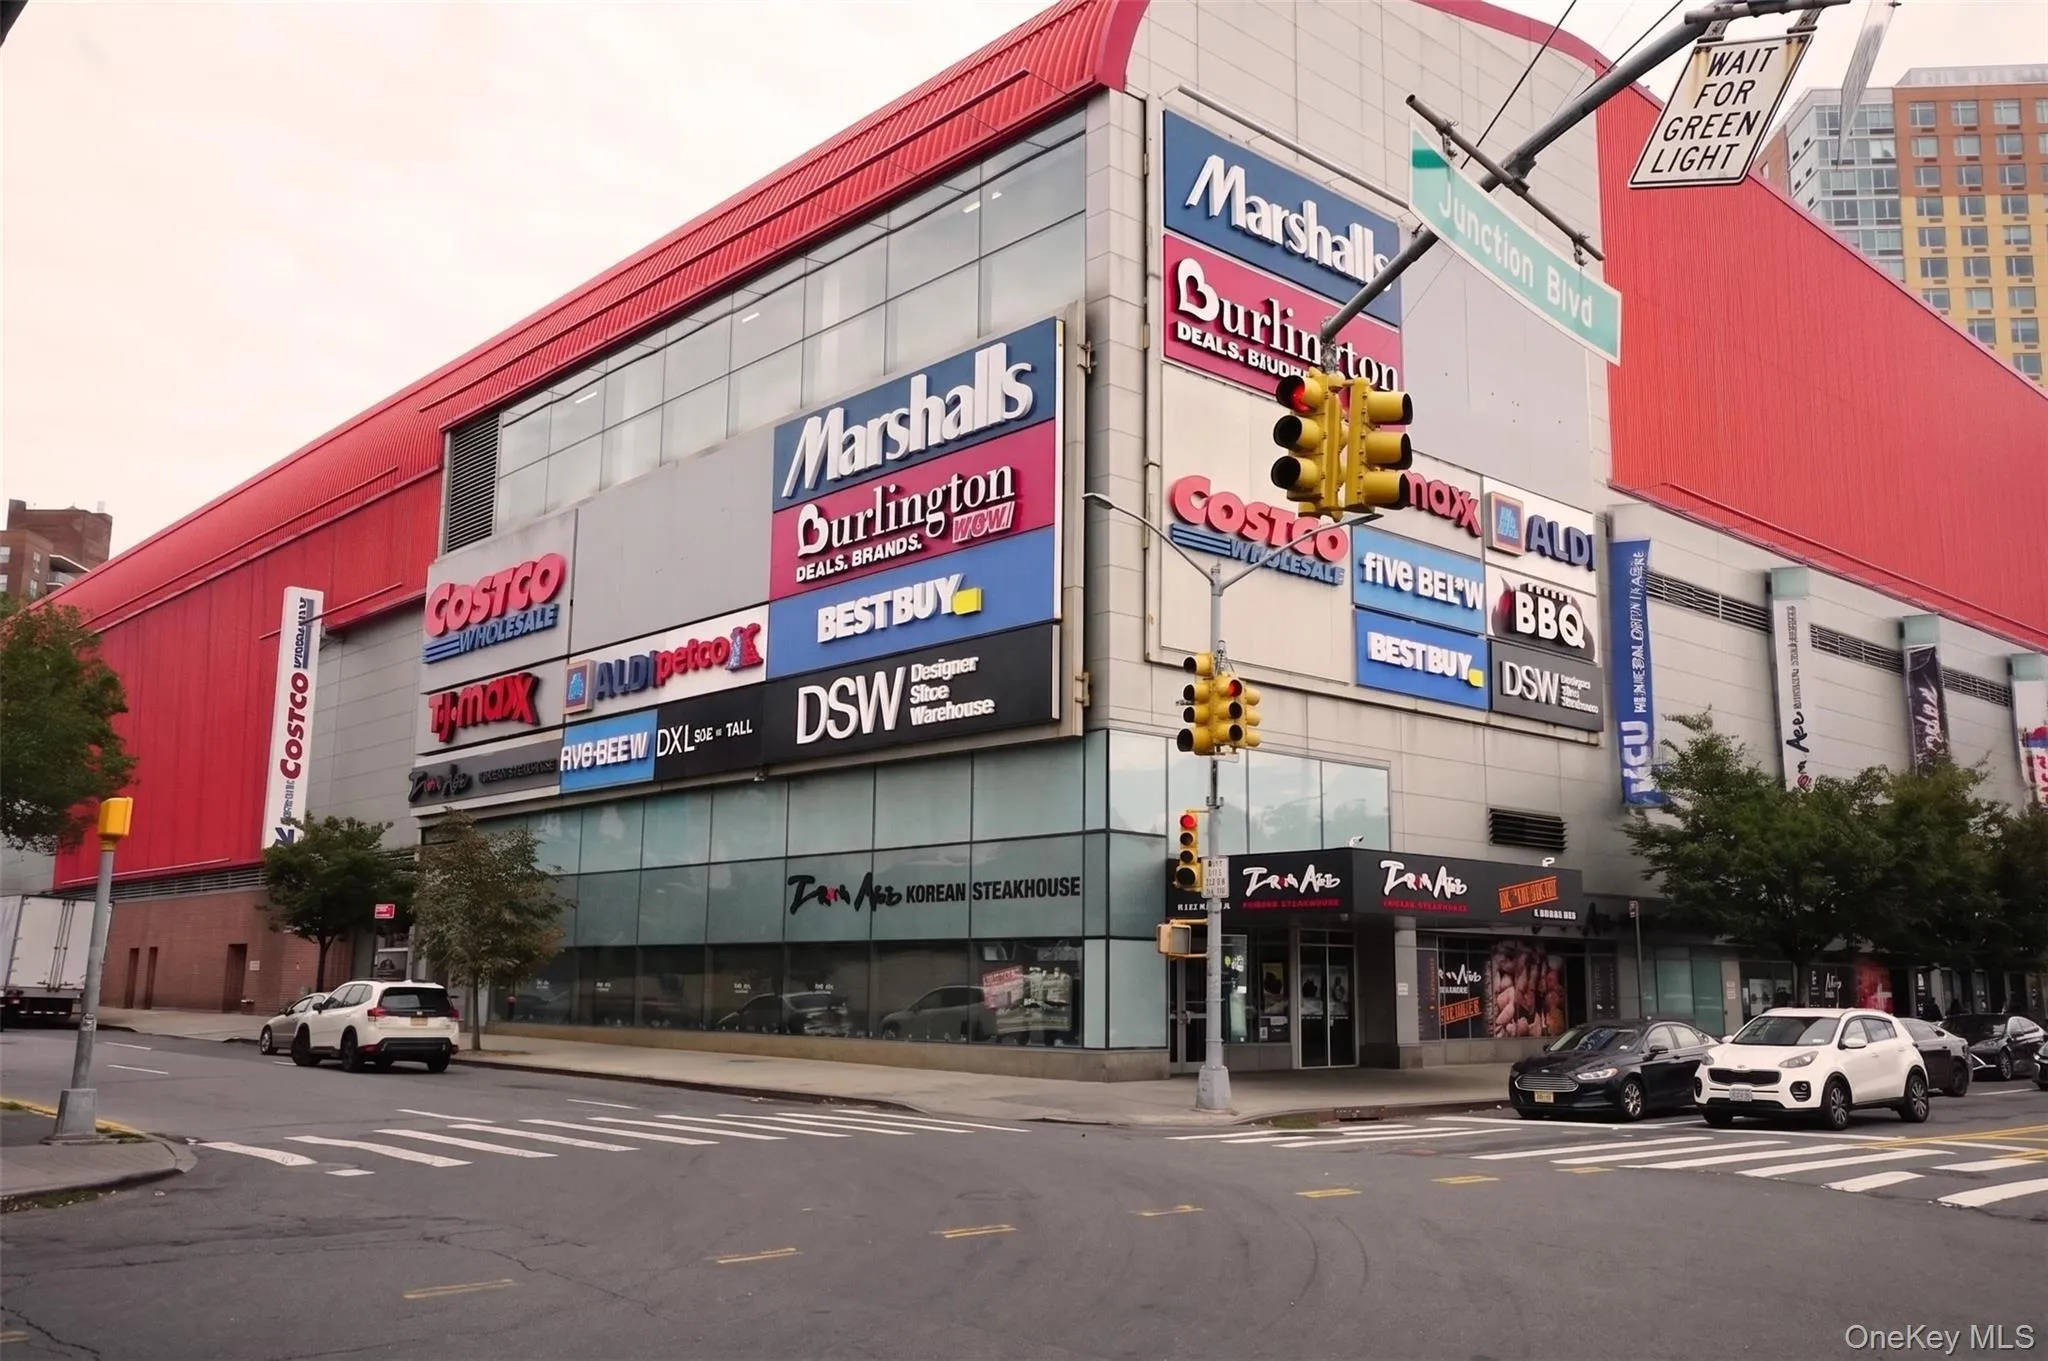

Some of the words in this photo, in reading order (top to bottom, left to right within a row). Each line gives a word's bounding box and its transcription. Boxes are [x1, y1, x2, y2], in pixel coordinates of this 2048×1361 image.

[1705, 46, 1778, 78] WAIT
[1699, 79, 1756, 110] FOR
[1663, 109, 1761, 142] GREEN
[1650, 143, 1740, 174] LIGHT
[1438, 181, 1534, 289] Junction
[1547, 264, 1593, 328] Blvd
[1177, 257, 1399, 391] Burlinton
[1177, 320, 1244, 362] DEALS.
[782, 342, 1033, 498] Marshalls
[796, 465, 1015, 558] Burlington
[1169, 475, 1349, 563] COSTCO
[796, 550, 848, 582] DEALS.
[852, 533, 922, 569] BRANDS.
[424, 552, 566, 638] COSTCO
[1514, 590, 1586, 649] BBQ
[458, 603, 559, 653] WHOLESALE
[796, 666, 907, 745] DSW
[1502, 660, 1560, 705] DSW
[280, 671, 309, 780] COSTCO
[909, 699, 995, 726] Warehouse
[656, 724, 695, 758] DXL
[726, 719, 753, 736] TALL
[906, 883, 966, 904] KOREAN
[972, 876, 1081, 900] STEAKHOUSE
